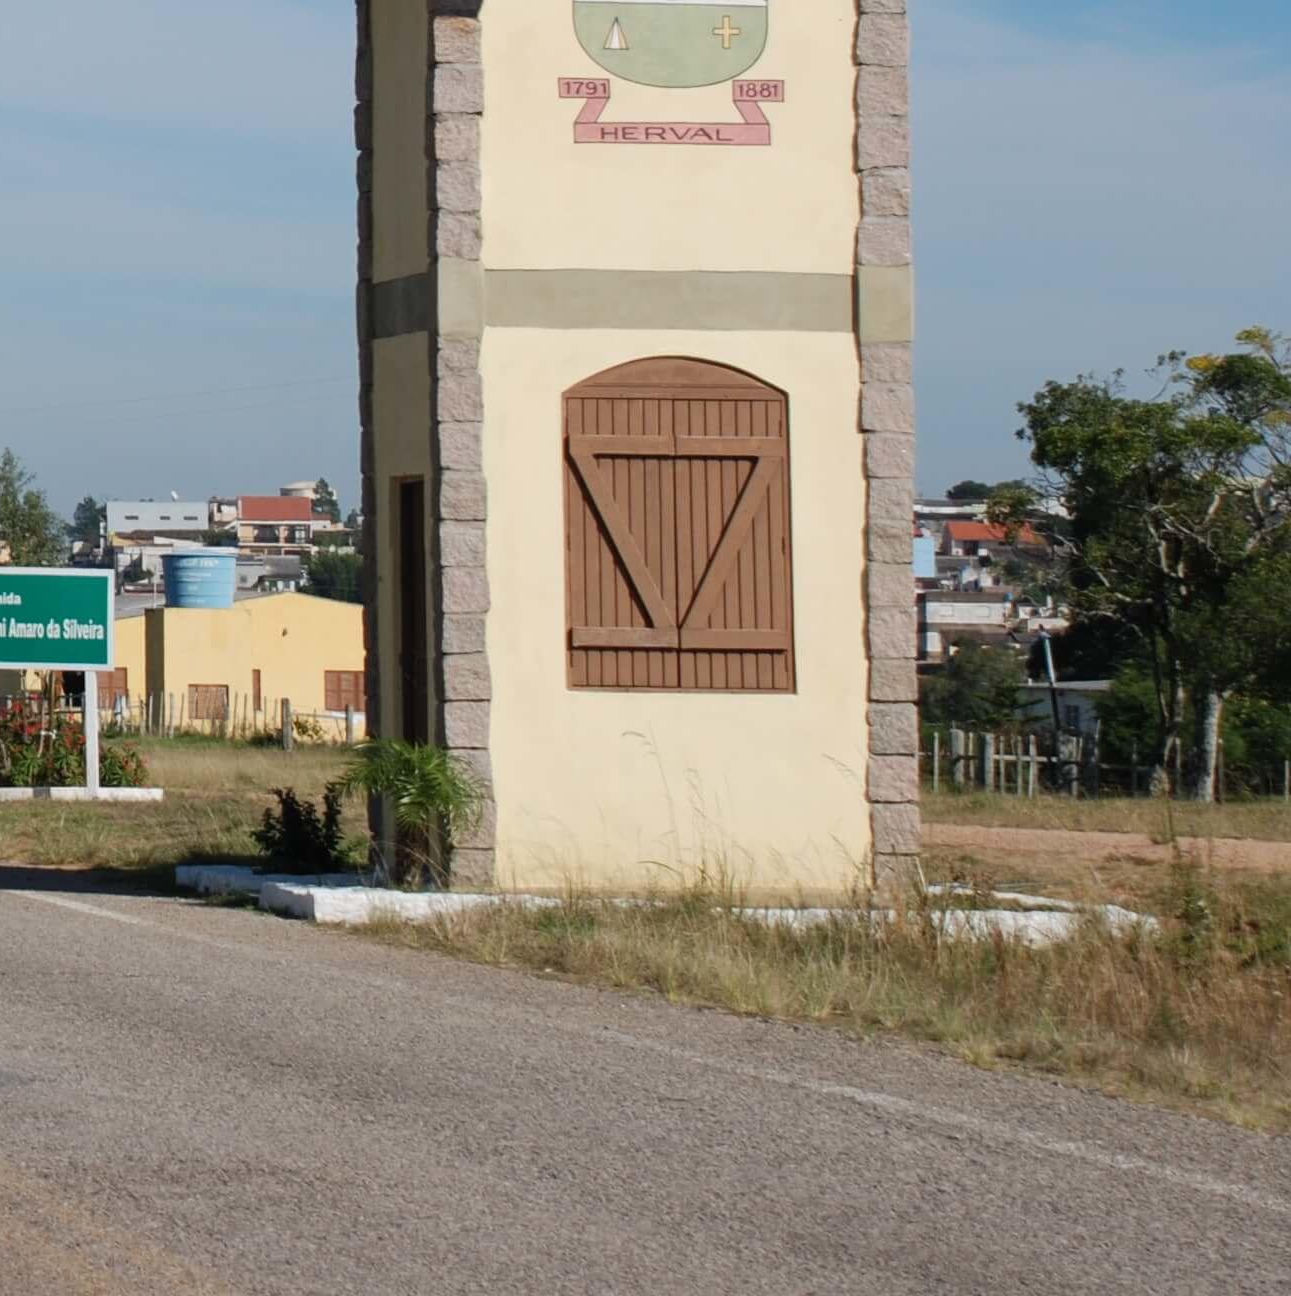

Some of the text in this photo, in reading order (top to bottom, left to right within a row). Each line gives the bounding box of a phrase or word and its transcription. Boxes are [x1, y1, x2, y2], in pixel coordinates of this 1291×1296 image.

[564, 80, 608, 96] 1791
[738, 83, 779, 99] 1881
[599, 126, 734, 142] HERVAL
[8, 617, 45, 639] Amaro
[46, 618, 61, 639] da
[62, 618, 105, 640] Silveira
